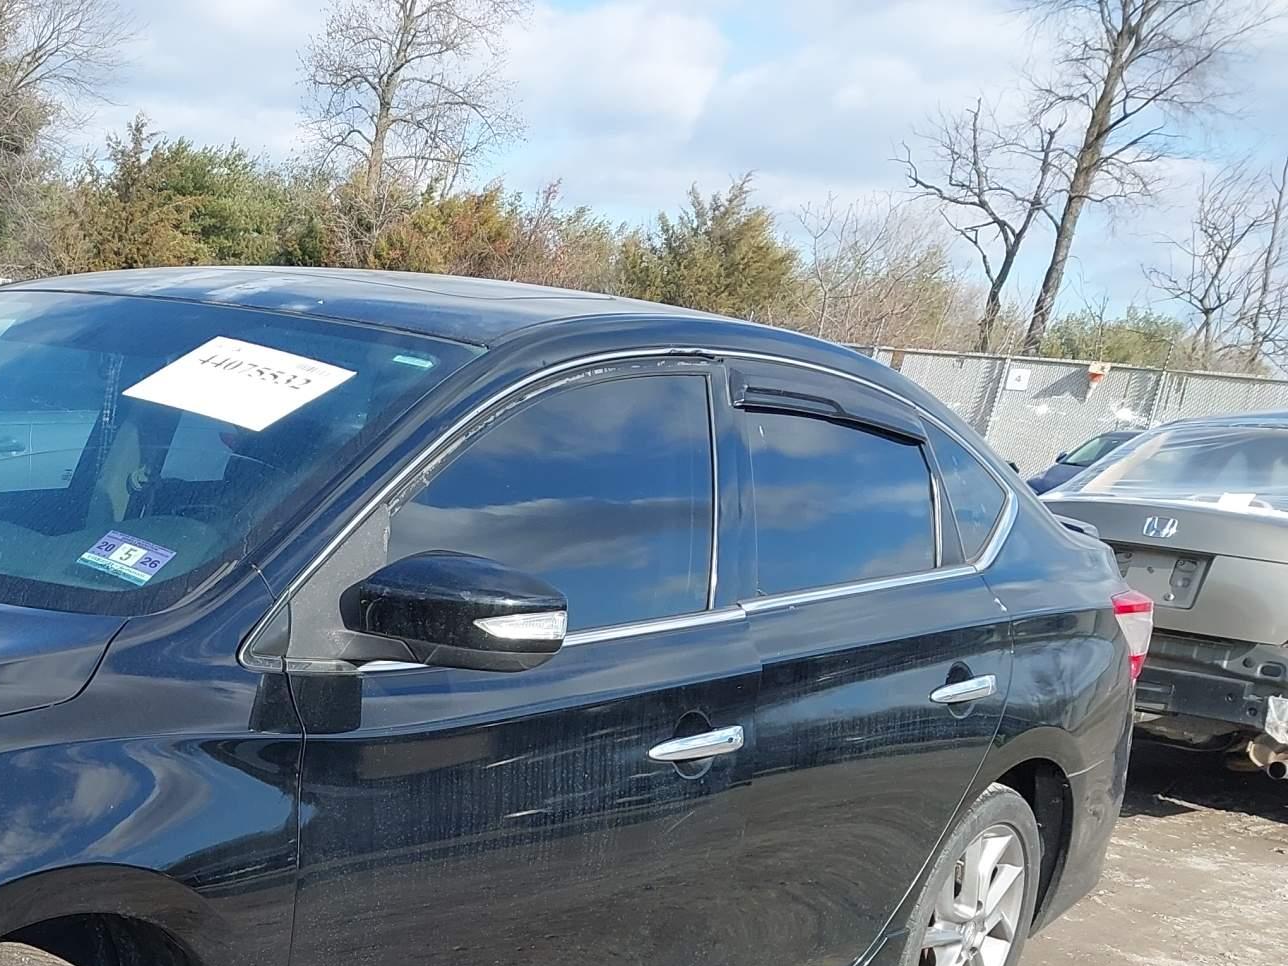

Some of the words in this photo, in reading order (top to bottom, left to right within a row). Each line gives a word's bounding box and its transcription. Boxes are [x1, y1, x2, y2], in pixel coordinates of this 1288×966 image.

[198, 354, 312, 390] 44075532
[96, 541, 116, 552] 20
[119, 548, 137, 561] 5
[140, 556, 161, 569] 26
